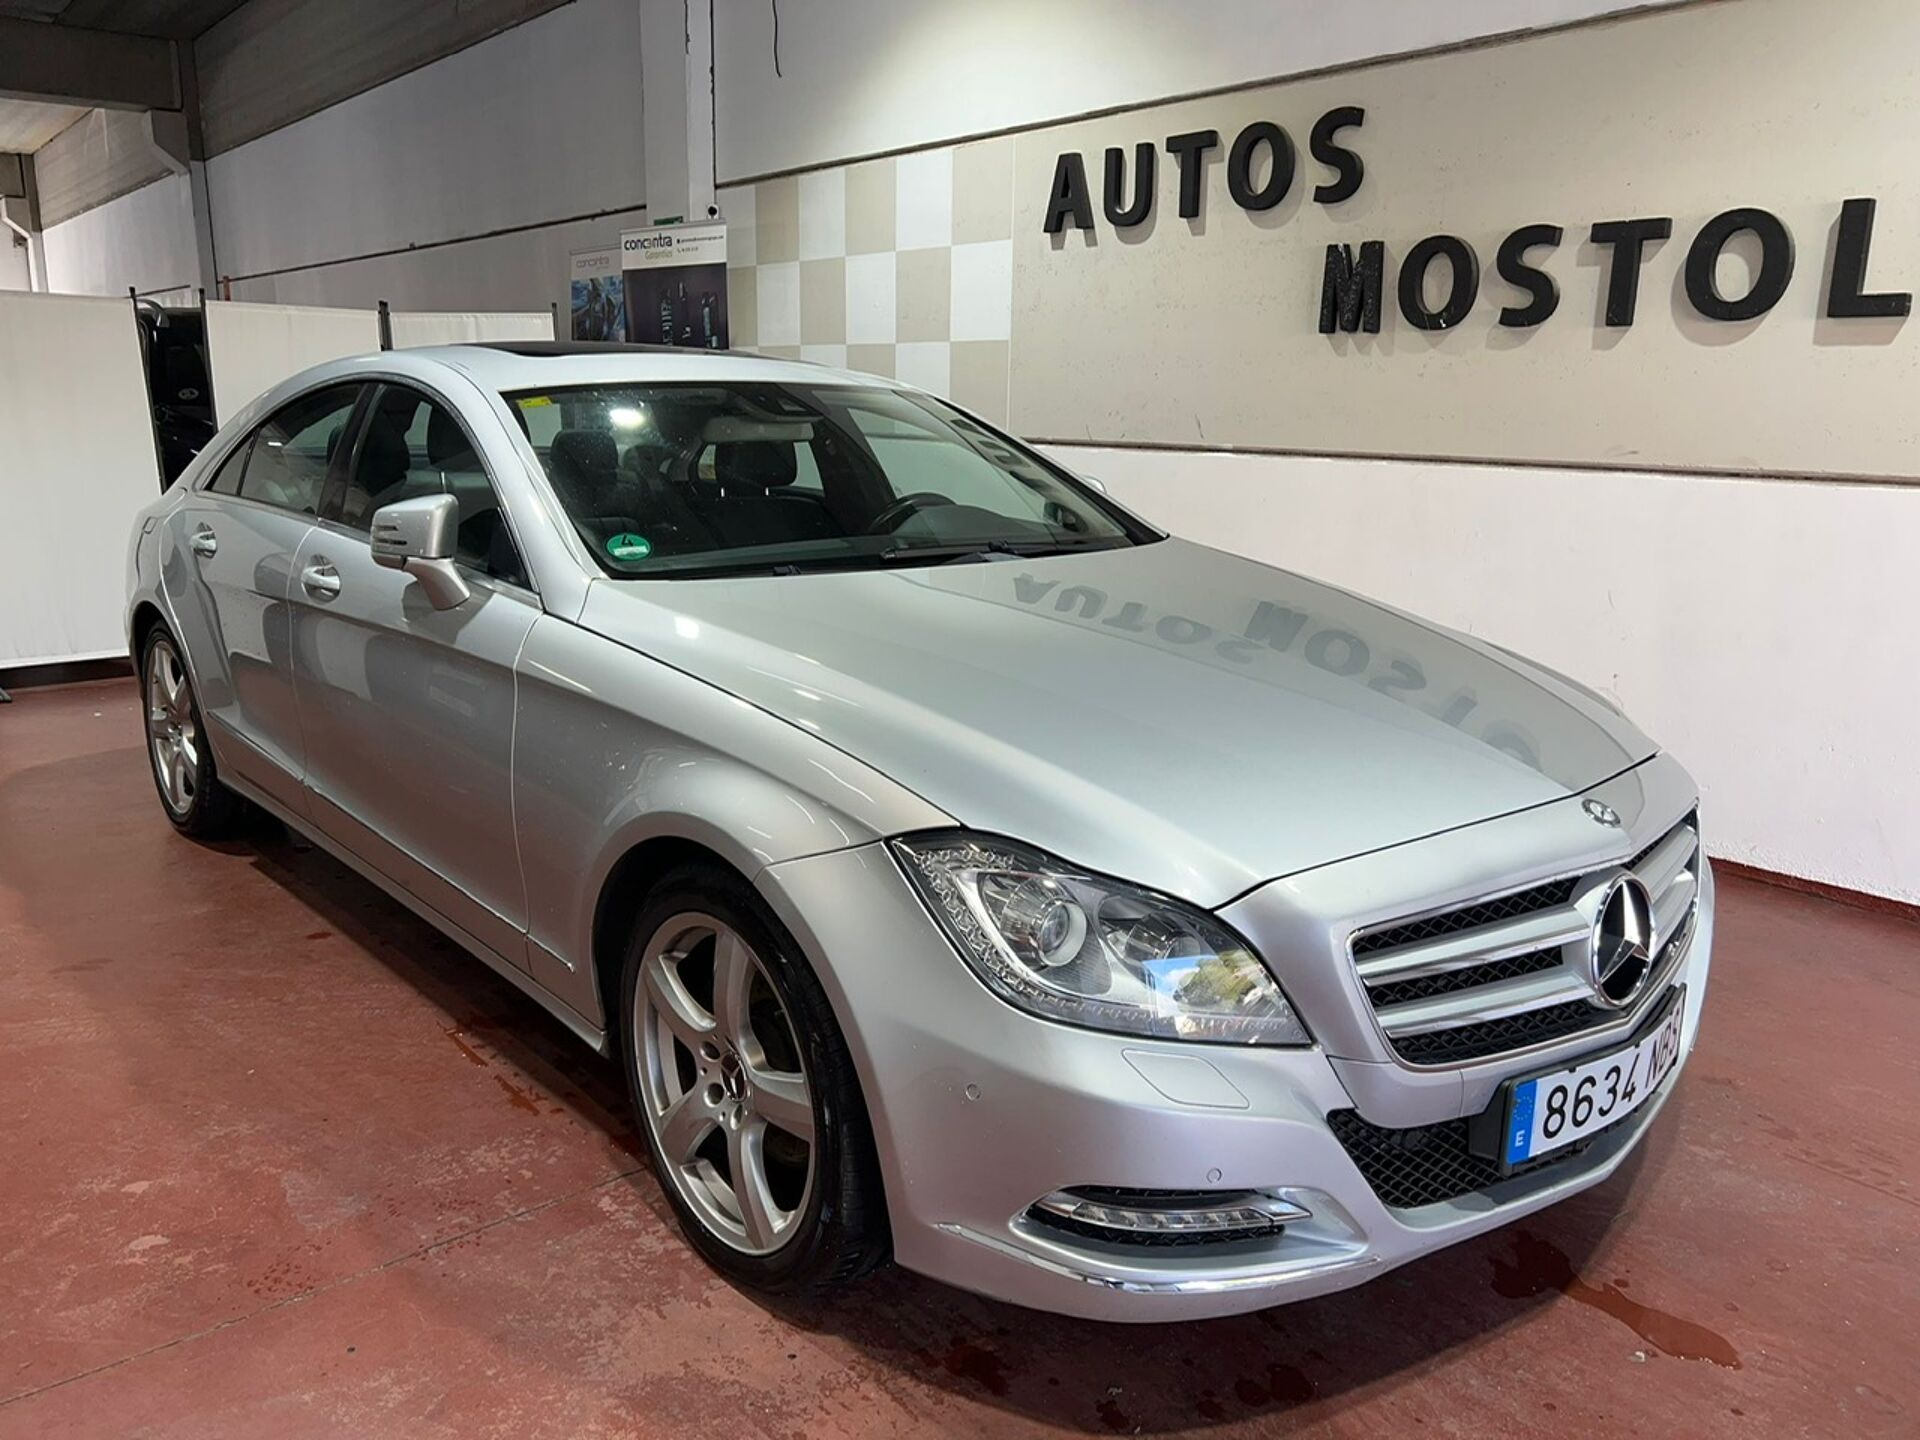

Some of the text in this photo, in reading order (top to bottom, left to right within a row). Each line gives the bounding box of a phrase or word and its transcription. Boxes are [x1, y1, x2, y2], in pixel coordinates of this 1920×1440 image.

[1043, 107, 1365, 234] AUTOS
[1318, 197, 1912, 335] MOSTOL
[1515, 1129, 1525, 1147] E
[1542, 1053, 1640, 1139] 8634
